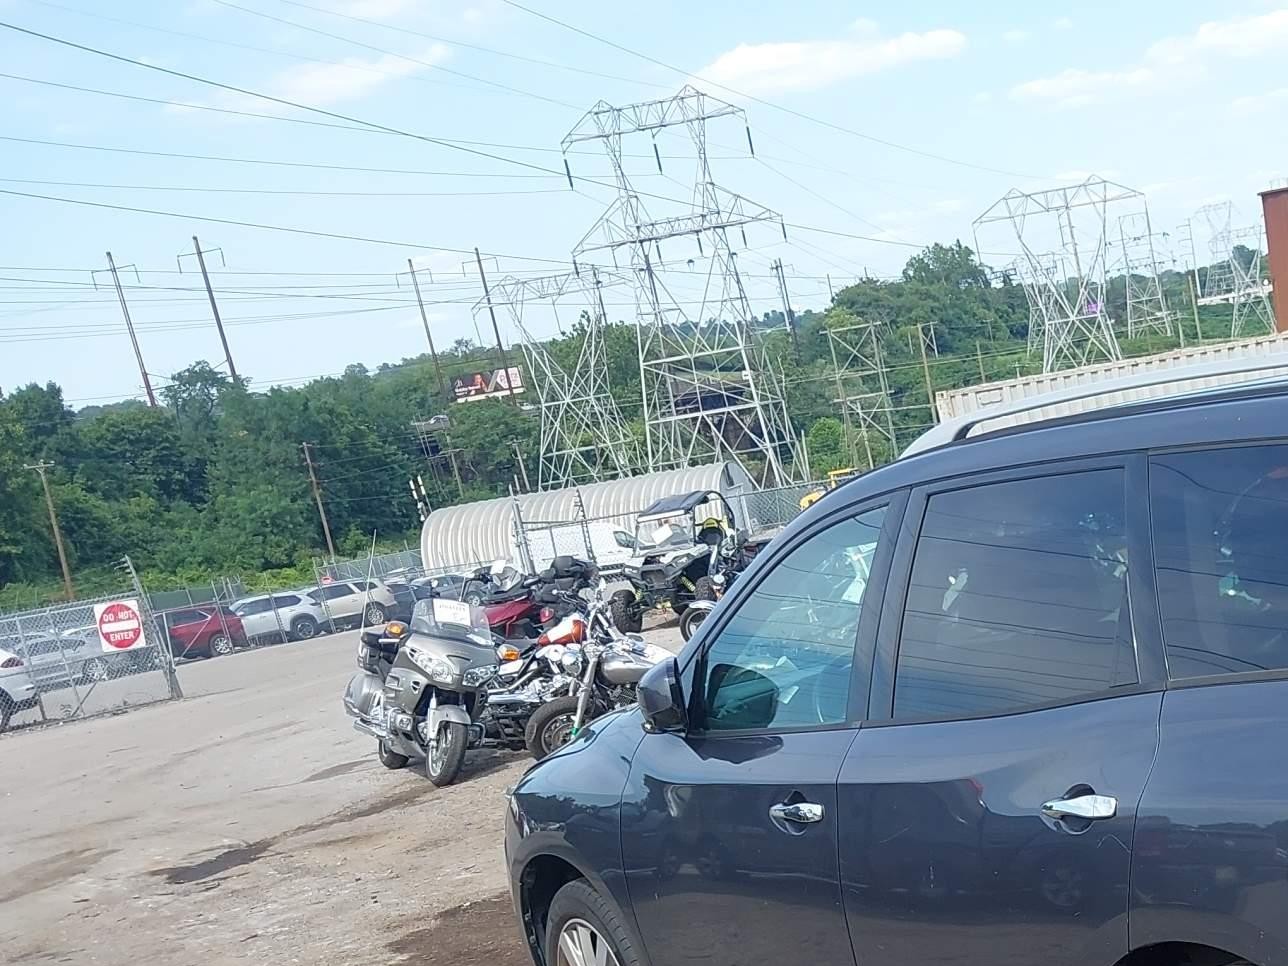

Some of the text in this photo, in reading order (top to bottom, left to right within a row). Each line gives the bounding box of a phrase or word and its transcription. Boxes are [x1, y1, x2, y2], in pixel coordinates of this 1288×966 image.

[103, 610, 134, 622] DO NOT
[110, 630, 135, 642] ENTER
